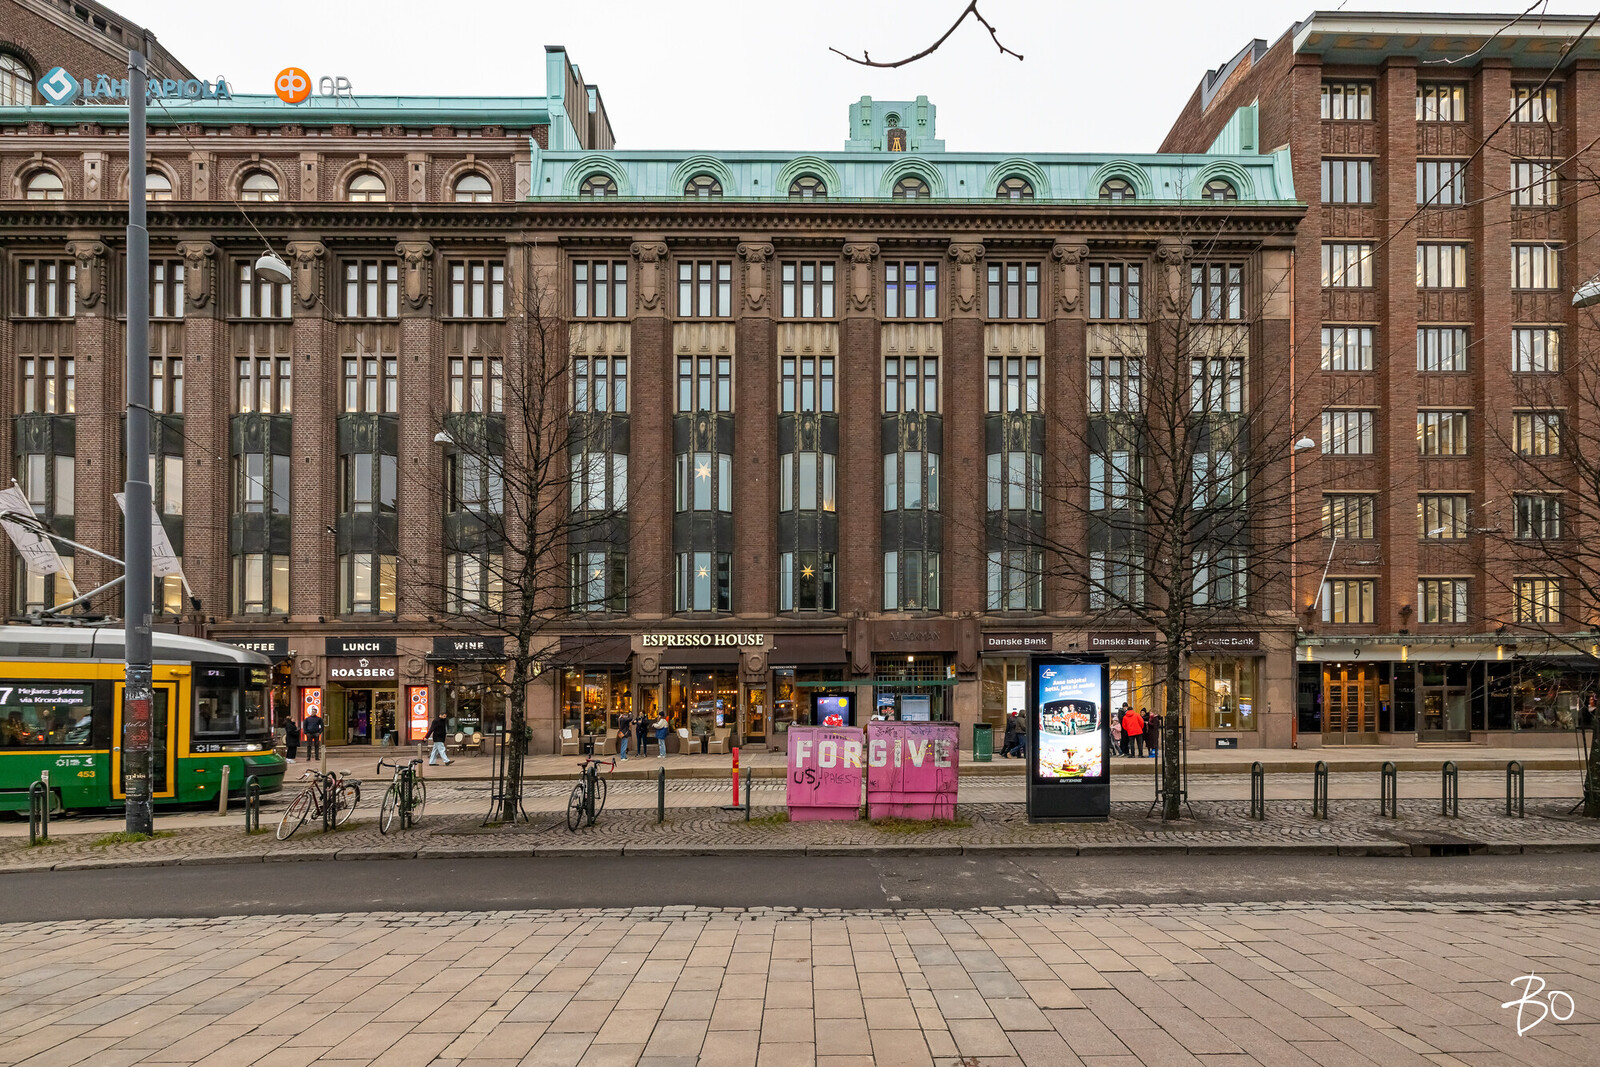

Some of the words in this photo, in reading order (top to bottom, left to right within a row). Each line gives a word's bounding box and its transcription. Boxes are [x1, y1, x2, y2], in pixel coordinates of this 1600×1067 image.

[83, 74, 230, 99] LÄHAPIOLA
[319, 76, 352, 97] OP
[453, 641, 484, 650] WINE
[643, 634, 712, 646] ESPRESSO
[714, 634, 764, 646] HOUSE
[988, 636, 1022, 647] Danske
[1024, 636, 1047, 646] Bank
[1092, 636, 1126, 647] Danske
[1128, 636, 1151, 646] Bank
[231, 643, 275, 651] OFFEE
[342, 643, 380, 651] LUNCH
[1353, 648, 1361, 659] 9
[331, 668, 395, 677] ROASBERG
[0, 687, 14, 705] 7
[795, 739, 953, 768] FORGIVE
[77, 770, 96, 778] 453
